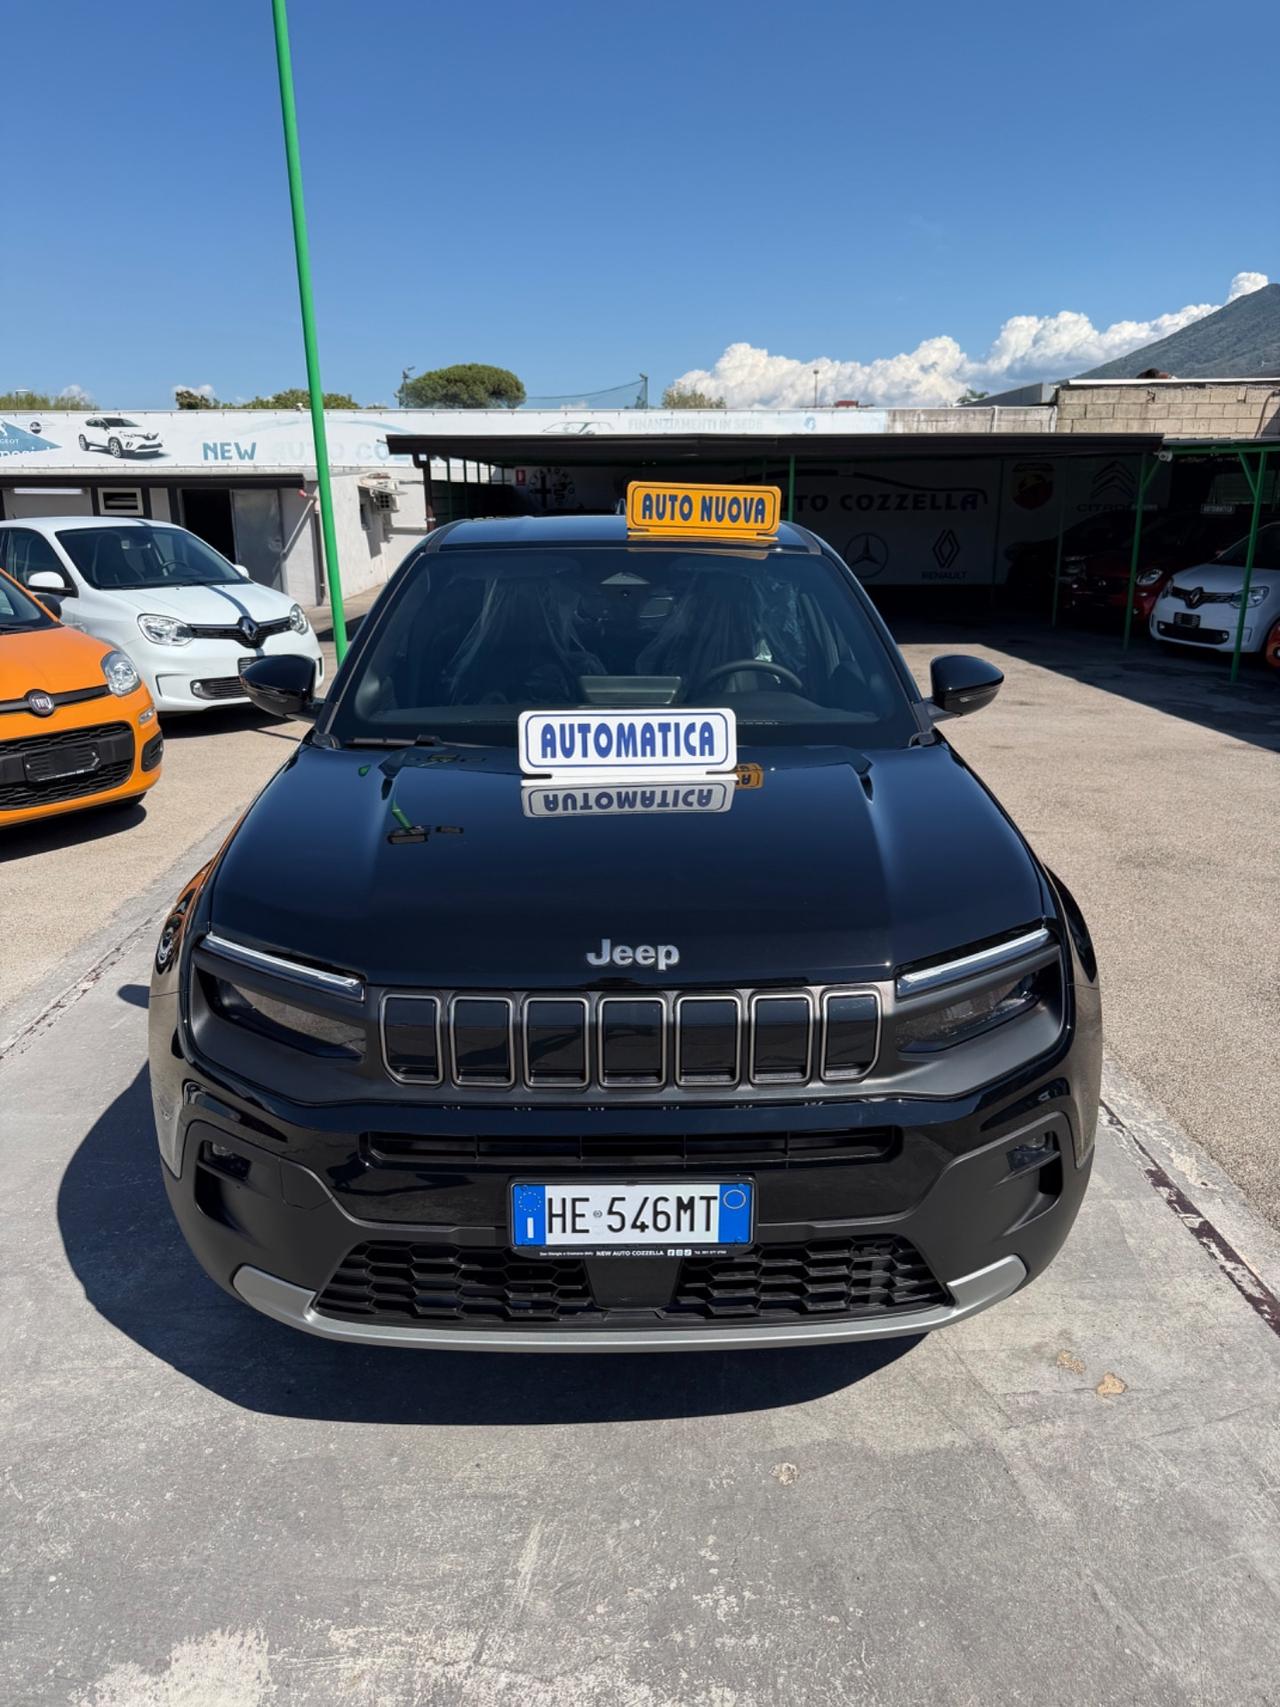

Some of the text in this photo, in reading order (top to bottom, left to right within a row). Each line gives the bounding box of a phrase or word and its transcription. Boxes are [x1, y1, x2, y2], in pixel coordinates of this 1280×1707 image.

[202, 442, 257, 461] NEW
[641, 493, 766, 524] AUTO NUOVA
[840, 494, 978, 511] COZZELLA
[921, 571, 968, 580] RENAULT
[540, 721, 715, 759] AUTOMATICA
[586, 938, 680, 971] Jeep
[547, 1195, 718, 1234] HE 546MT
